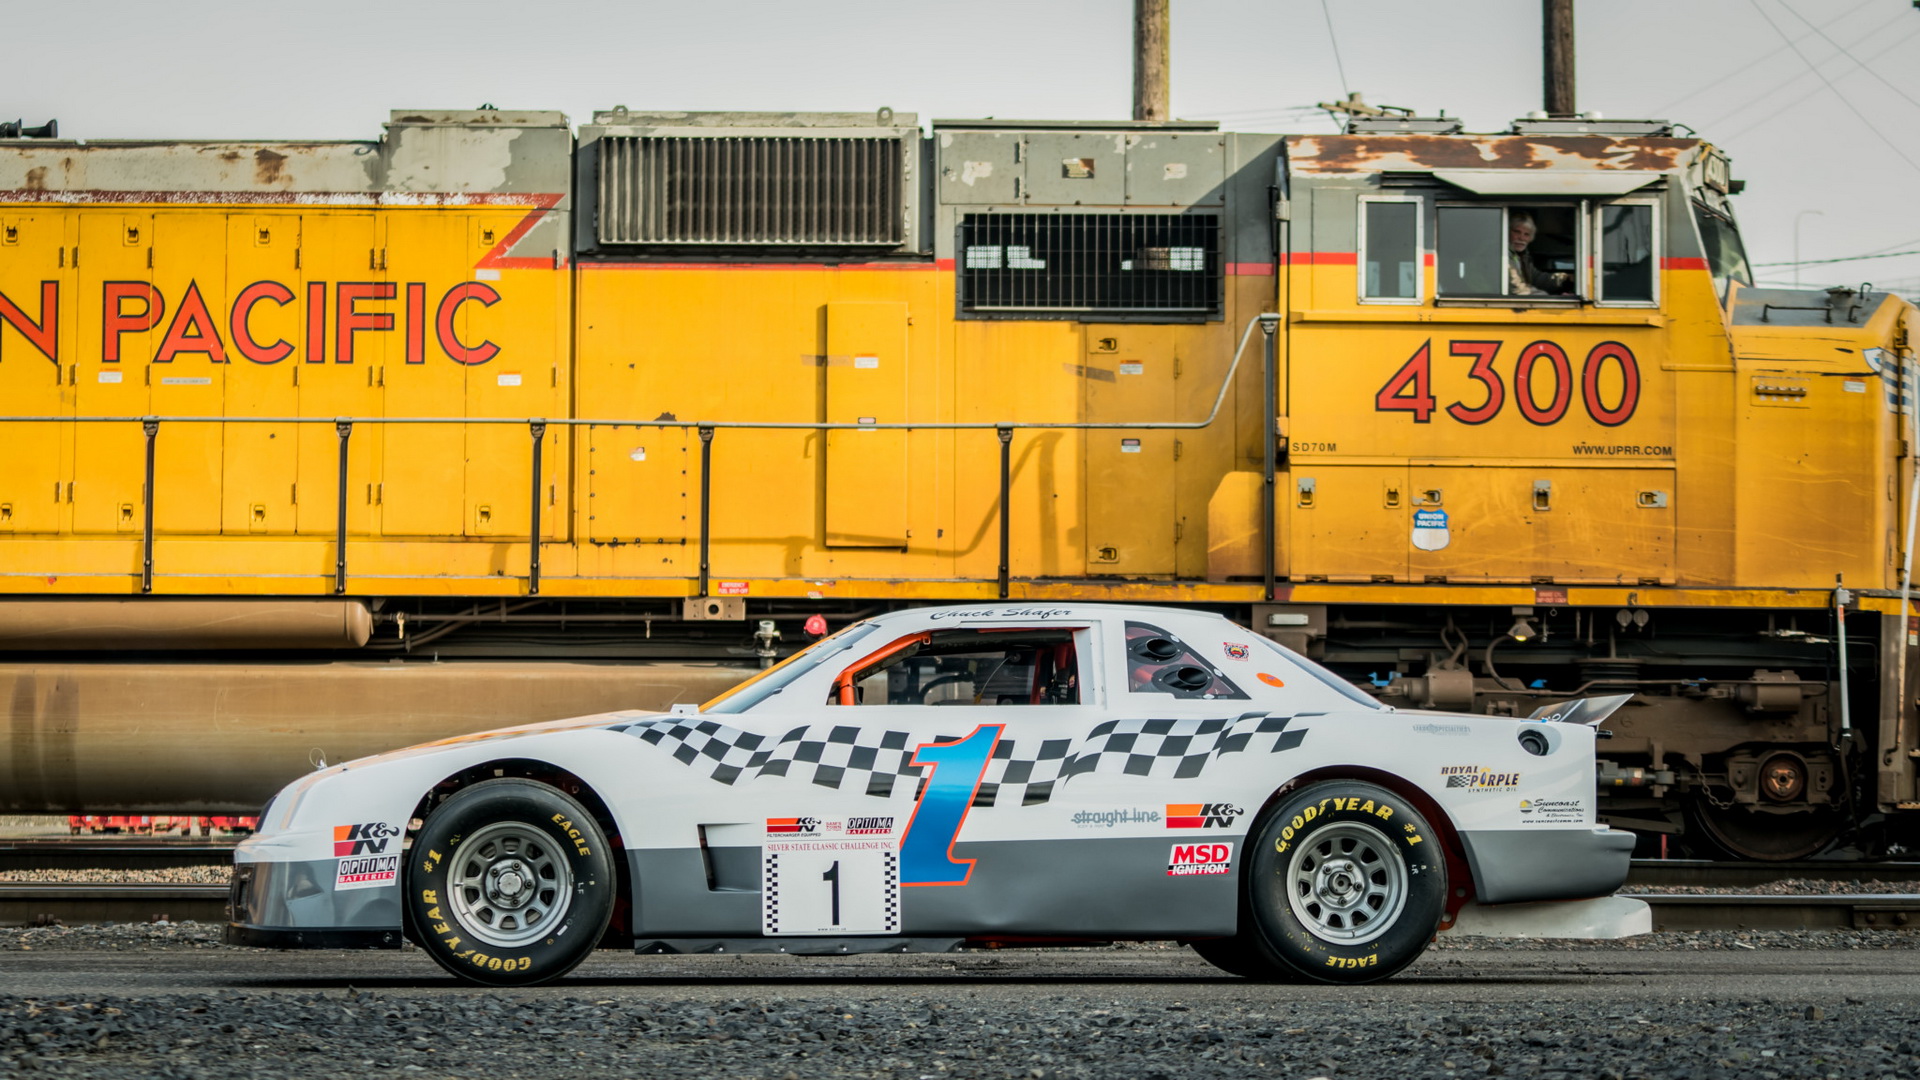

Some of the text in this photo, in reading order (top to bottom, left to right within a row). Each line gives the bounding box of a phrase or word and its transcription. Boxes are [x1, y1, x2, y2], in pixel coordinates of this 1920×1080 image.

[101, 278, 501, 366] PACIFIC
[1375, 337, 1641, 427] 4300
[1292, 442, 1337, 452] SD70M
[1572, 445, 1672, 456] WWW.UPRR.COM
[930, 608, 1072, 620] Chuck Shafer
[1440, 766, 1479, 775] ROYAL
[899, 723, 1007, 888] 1
[1534, 798, 1580, 807] Suncoast
[796, 817, 822, 832] K&N
[847, 817, 894, 829] OPTIMA
[1071, 806, 1162, 828] straight line
[1199, 803, 1245, 829] K&N
[1274, 797, 1424, 853] GOODYEAR #1
[346, 822, 400, 856] K&N
[551, 813, 591, 857] EAGLE
[767, 841, 895, 852] SILVER STATE CLASSIC CHALLENGE INC.
[1173, 844, 1230, 865] MSD
[340, 856, 397, 875] OPTIMA
[1171, 863, 1227, 875] IGNITION
[338, 871, 395, 883] BATTERIES
[822, 860, 839, 925] 1
[422, 849, 532, 972] GOODYEAR #1
[1325, 954, 1379, 969] EAGLE
